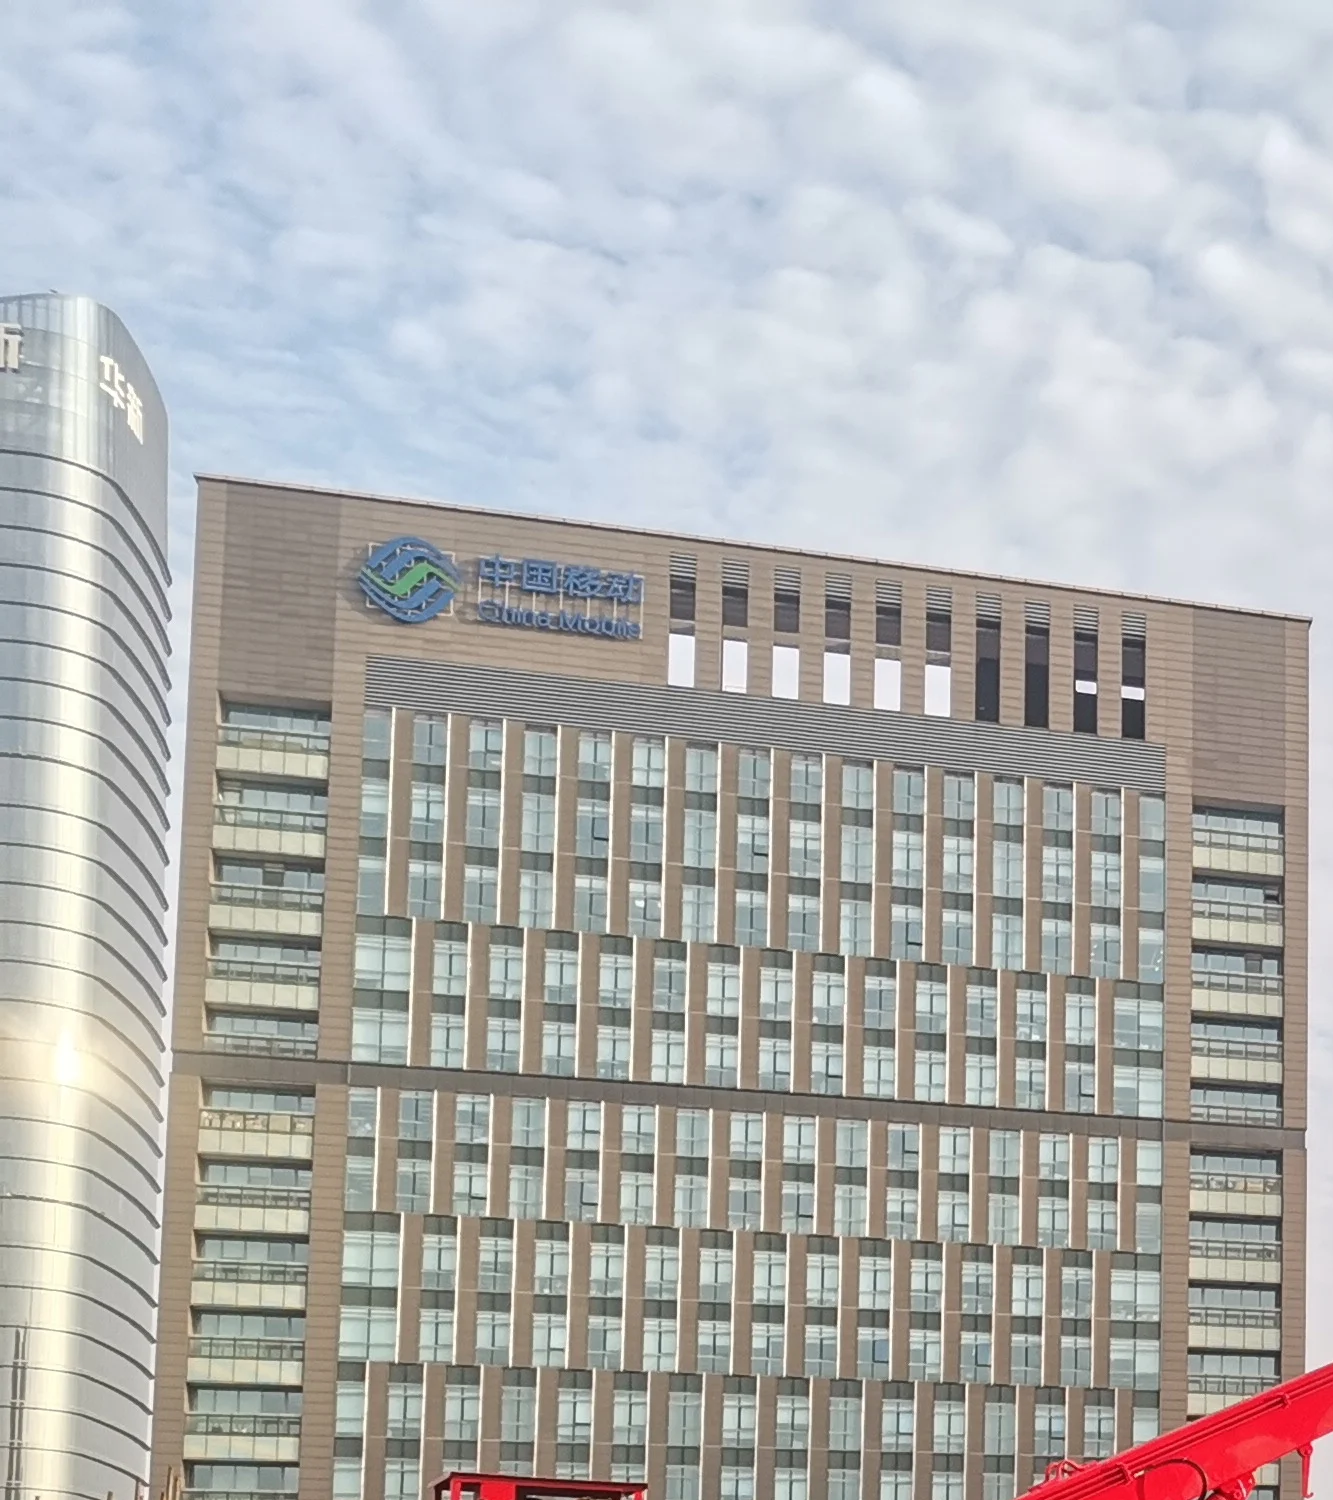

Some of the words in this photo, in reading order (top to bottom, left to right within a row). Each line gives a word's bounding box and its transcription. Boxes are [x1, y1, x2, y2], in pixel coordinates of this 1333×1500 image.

[479, 553, 644, 603] 中国移动
[478, 599, 550, 627] China
[559, 609, 641, 640] Mobile
